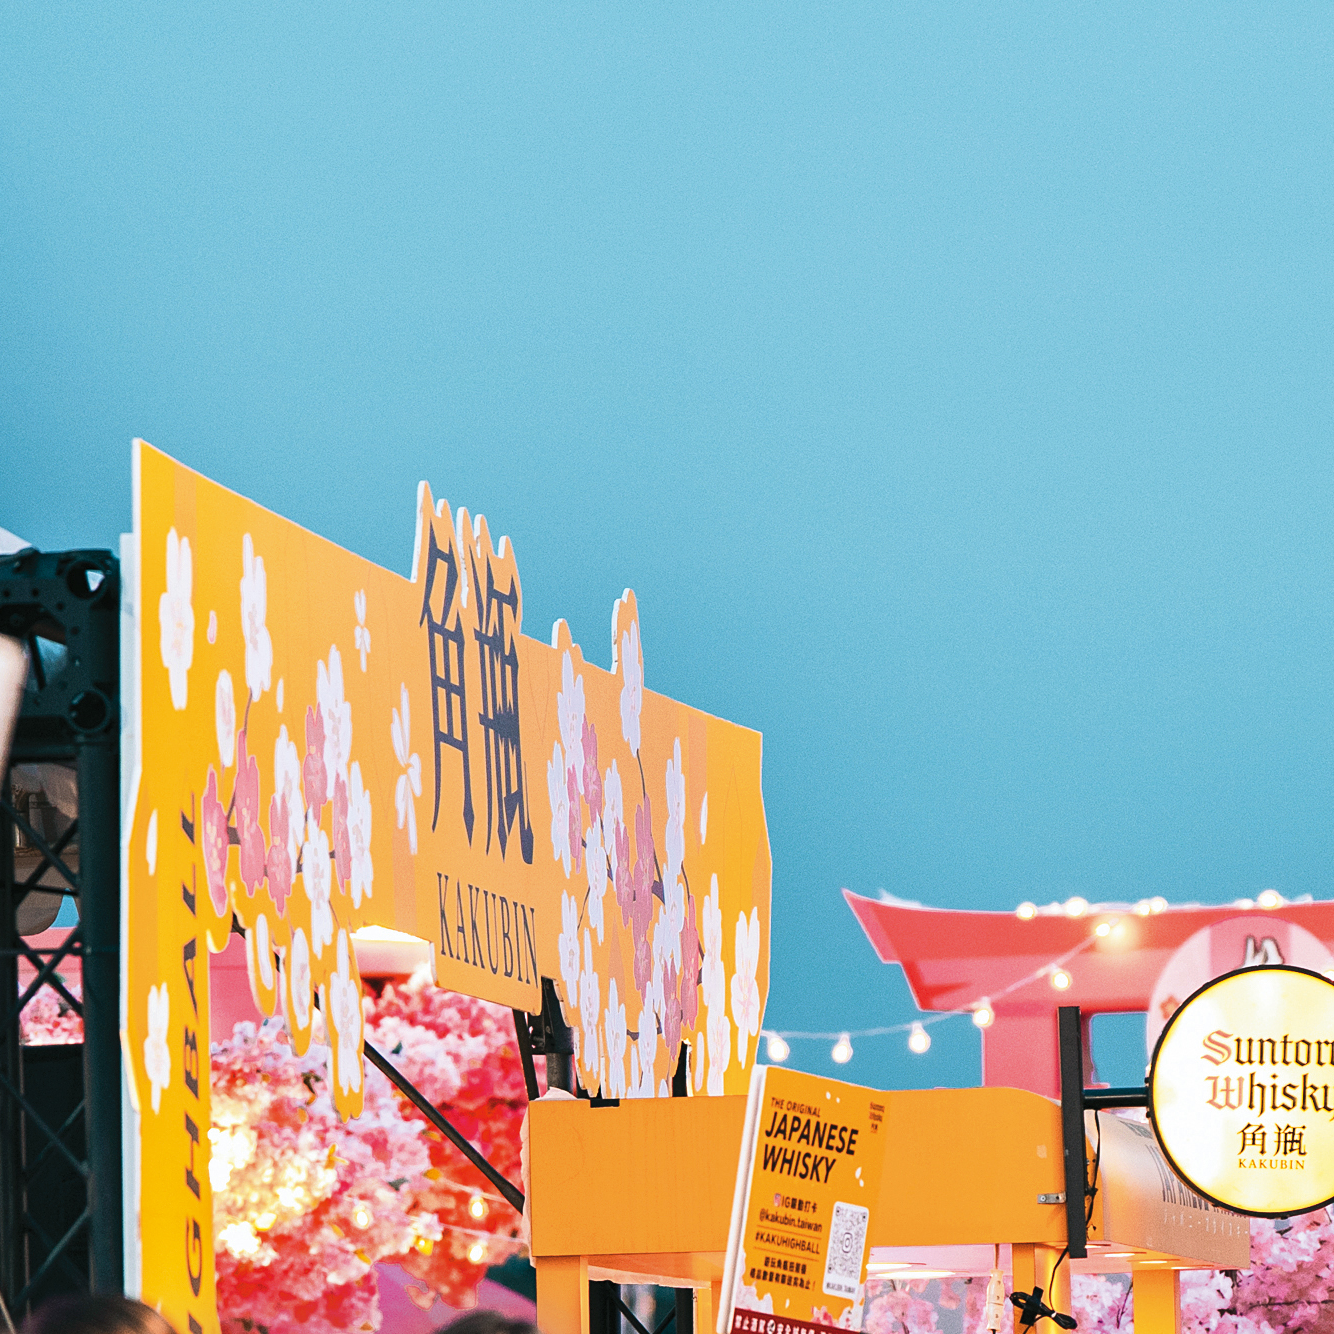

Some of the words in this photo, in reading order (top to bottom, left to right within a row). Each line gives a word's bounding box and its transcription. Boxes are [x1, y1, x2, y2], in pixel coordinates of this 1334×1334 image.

[420, 519, 534, 865] 角瓶
[436, 871, 539, 989] KAKUBIN
[771, 1097, 785, 1110] THE
[786, 1100, 821, 1118] ORIGINAL
[765, 1111, 859, 1156] JAPANESE
[1237, 1123, 1307, 1157] 角瓶
[763, 1143, 837, 1184] WHISKY
[1238, 1158, 1306, 1170] KAKUBIN
[759, 1208, 823, 1233] @kakubin.taiwan
[755, 1231, 820, 1255] #KAKUHIGHBALL
